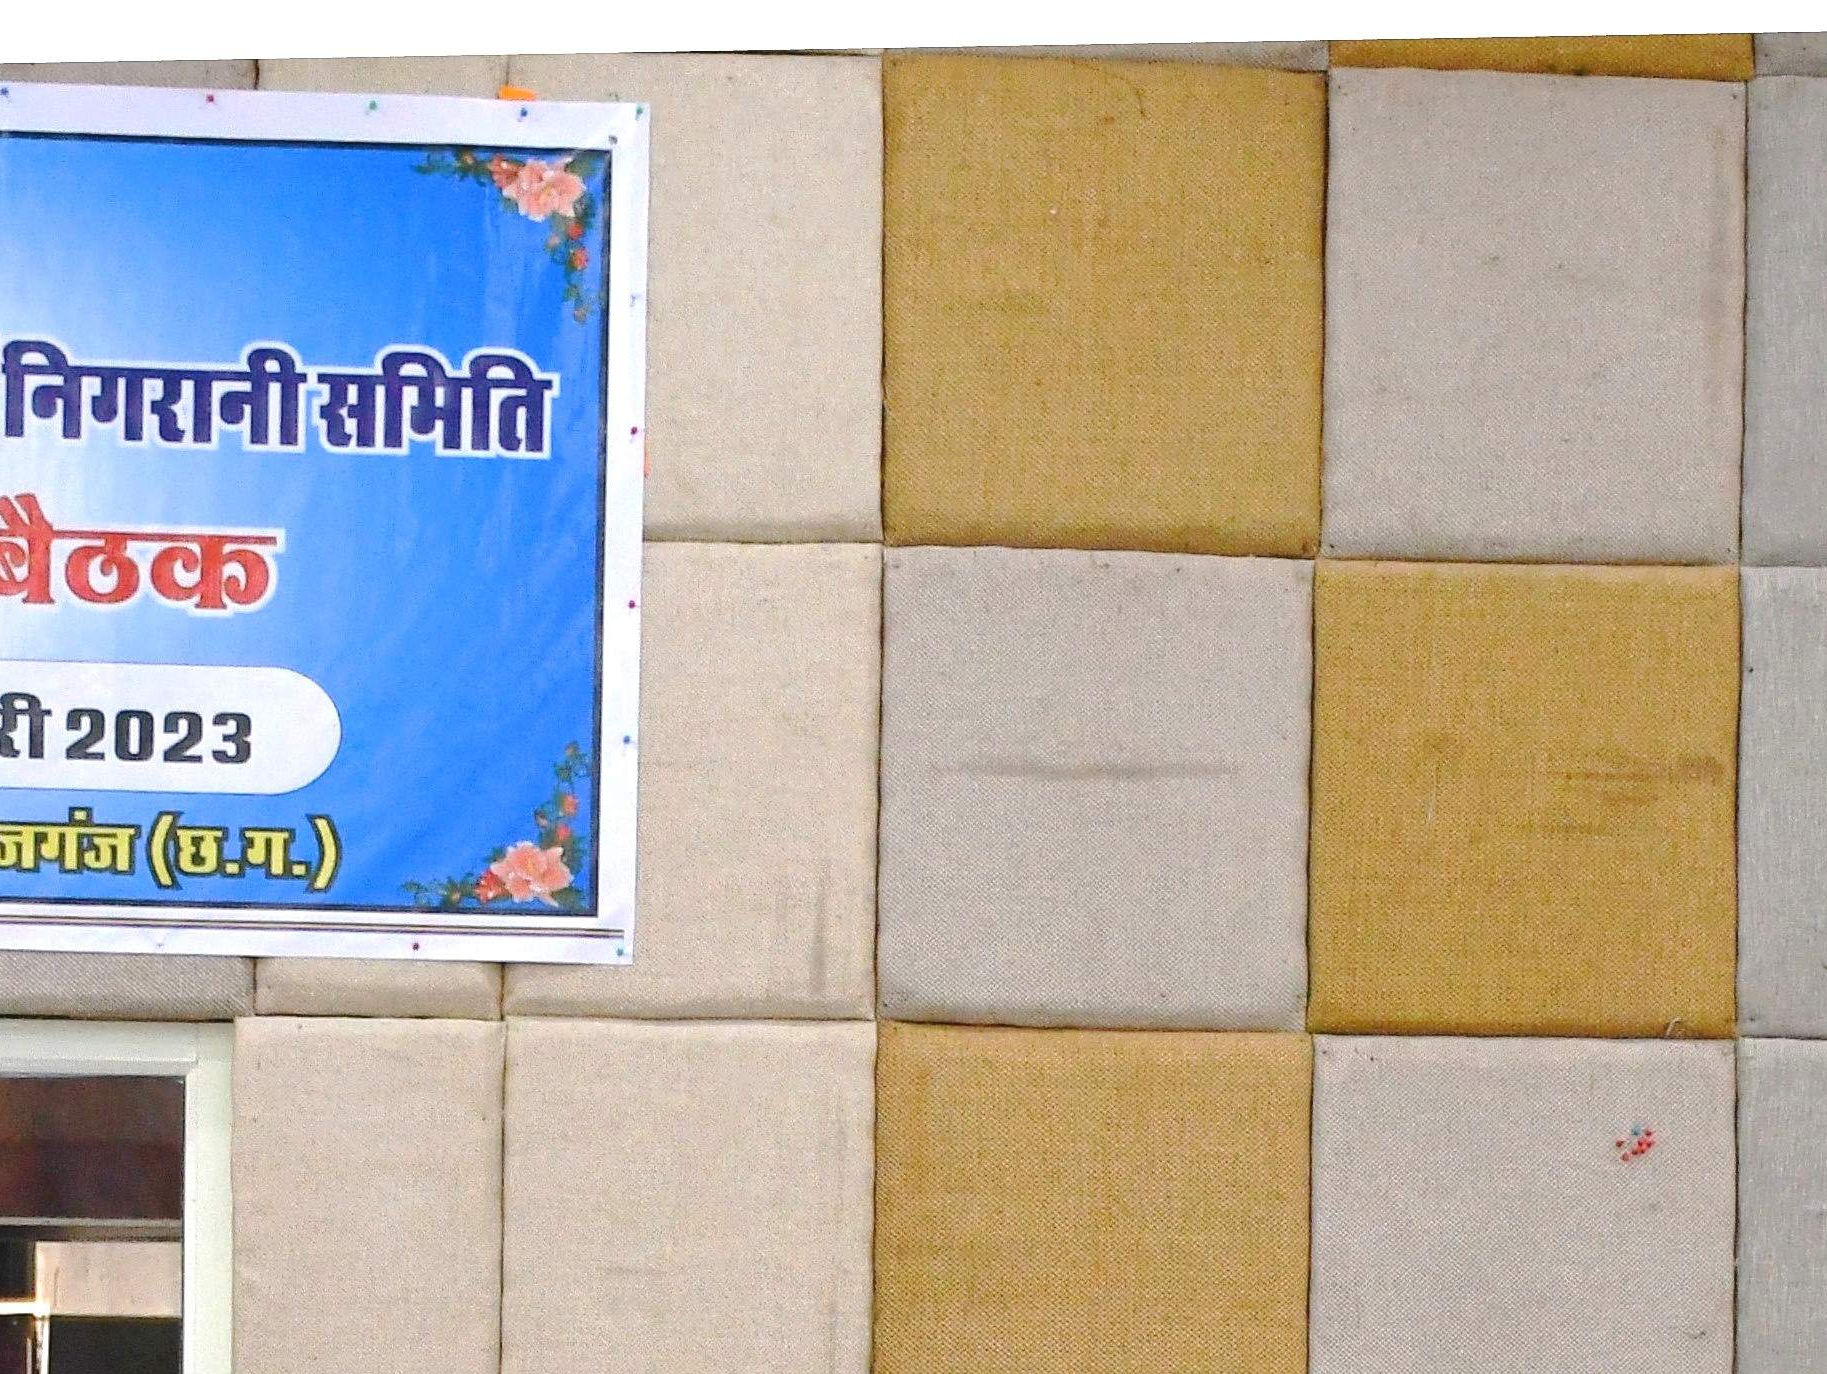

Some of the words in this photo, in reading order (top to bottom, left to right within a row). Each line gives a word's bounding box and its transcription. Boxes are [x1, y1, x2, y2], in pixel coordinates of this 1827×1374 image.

[2, 339, 306, 446] निगरानी
[314, 352, 553, 453] समिति
[64, 706, 253, 765] 2023
[146, 810, 342, 894] (छ.ग.)
